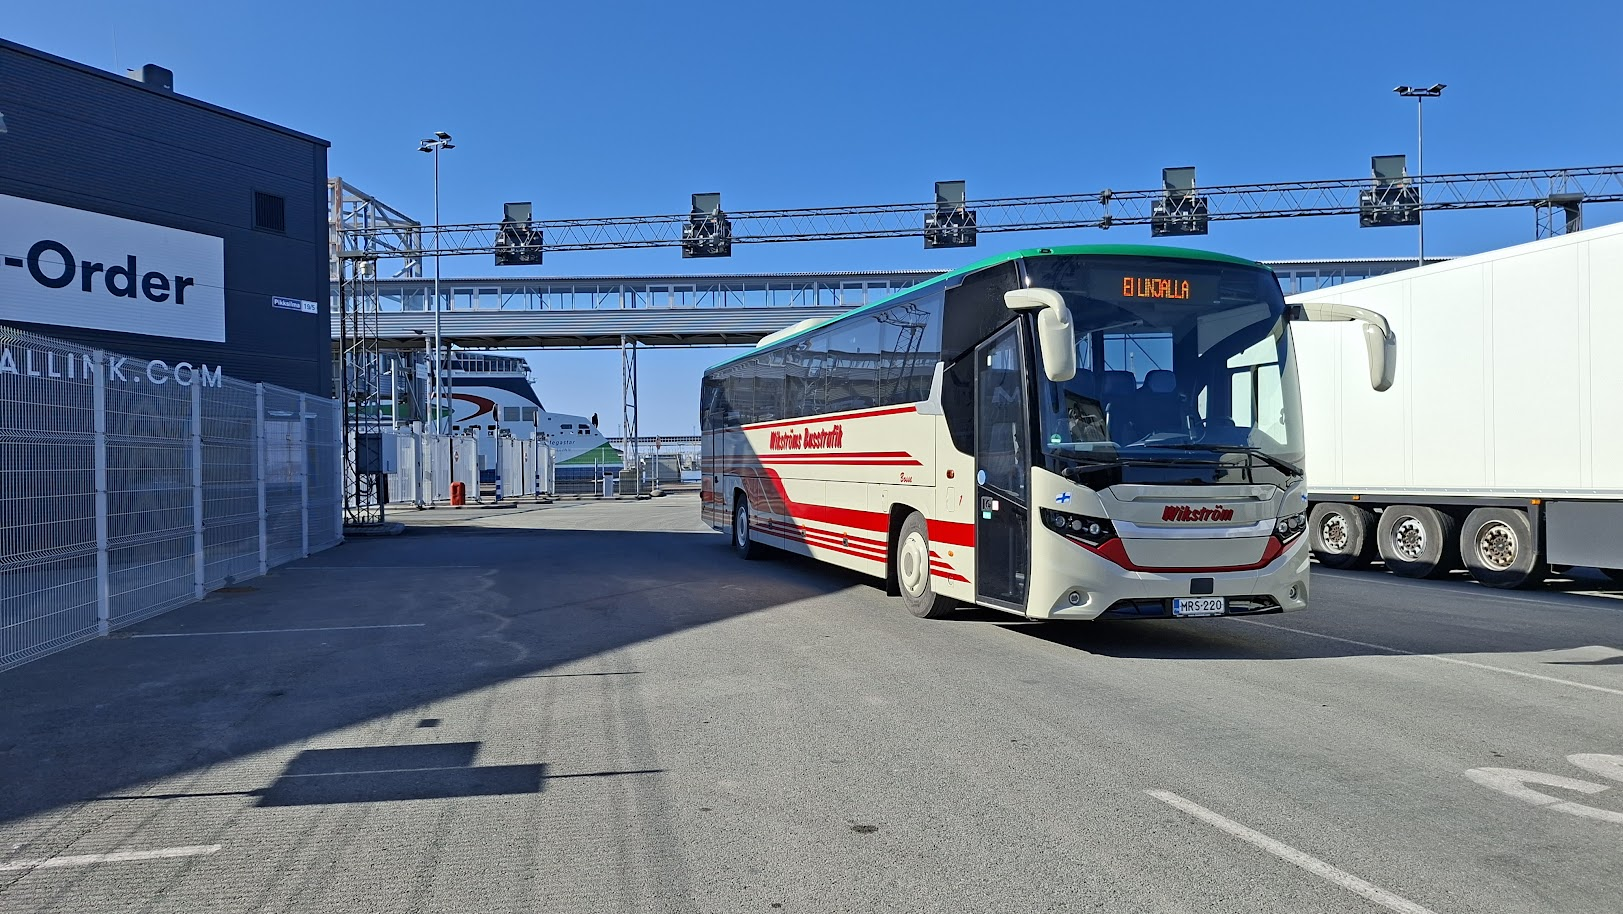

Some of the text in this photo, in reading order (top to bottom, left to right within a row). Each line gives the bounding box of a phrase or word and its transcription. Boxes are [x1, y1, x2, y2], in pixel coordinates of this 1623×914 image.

[1123, 277, 1189, 299] EI LINJALLA
[803, 424, 843, 450] Busstrafik
[1161, 504, 1235, 522] Wikström
[1180, 599, 1222, 612] MRS-220
